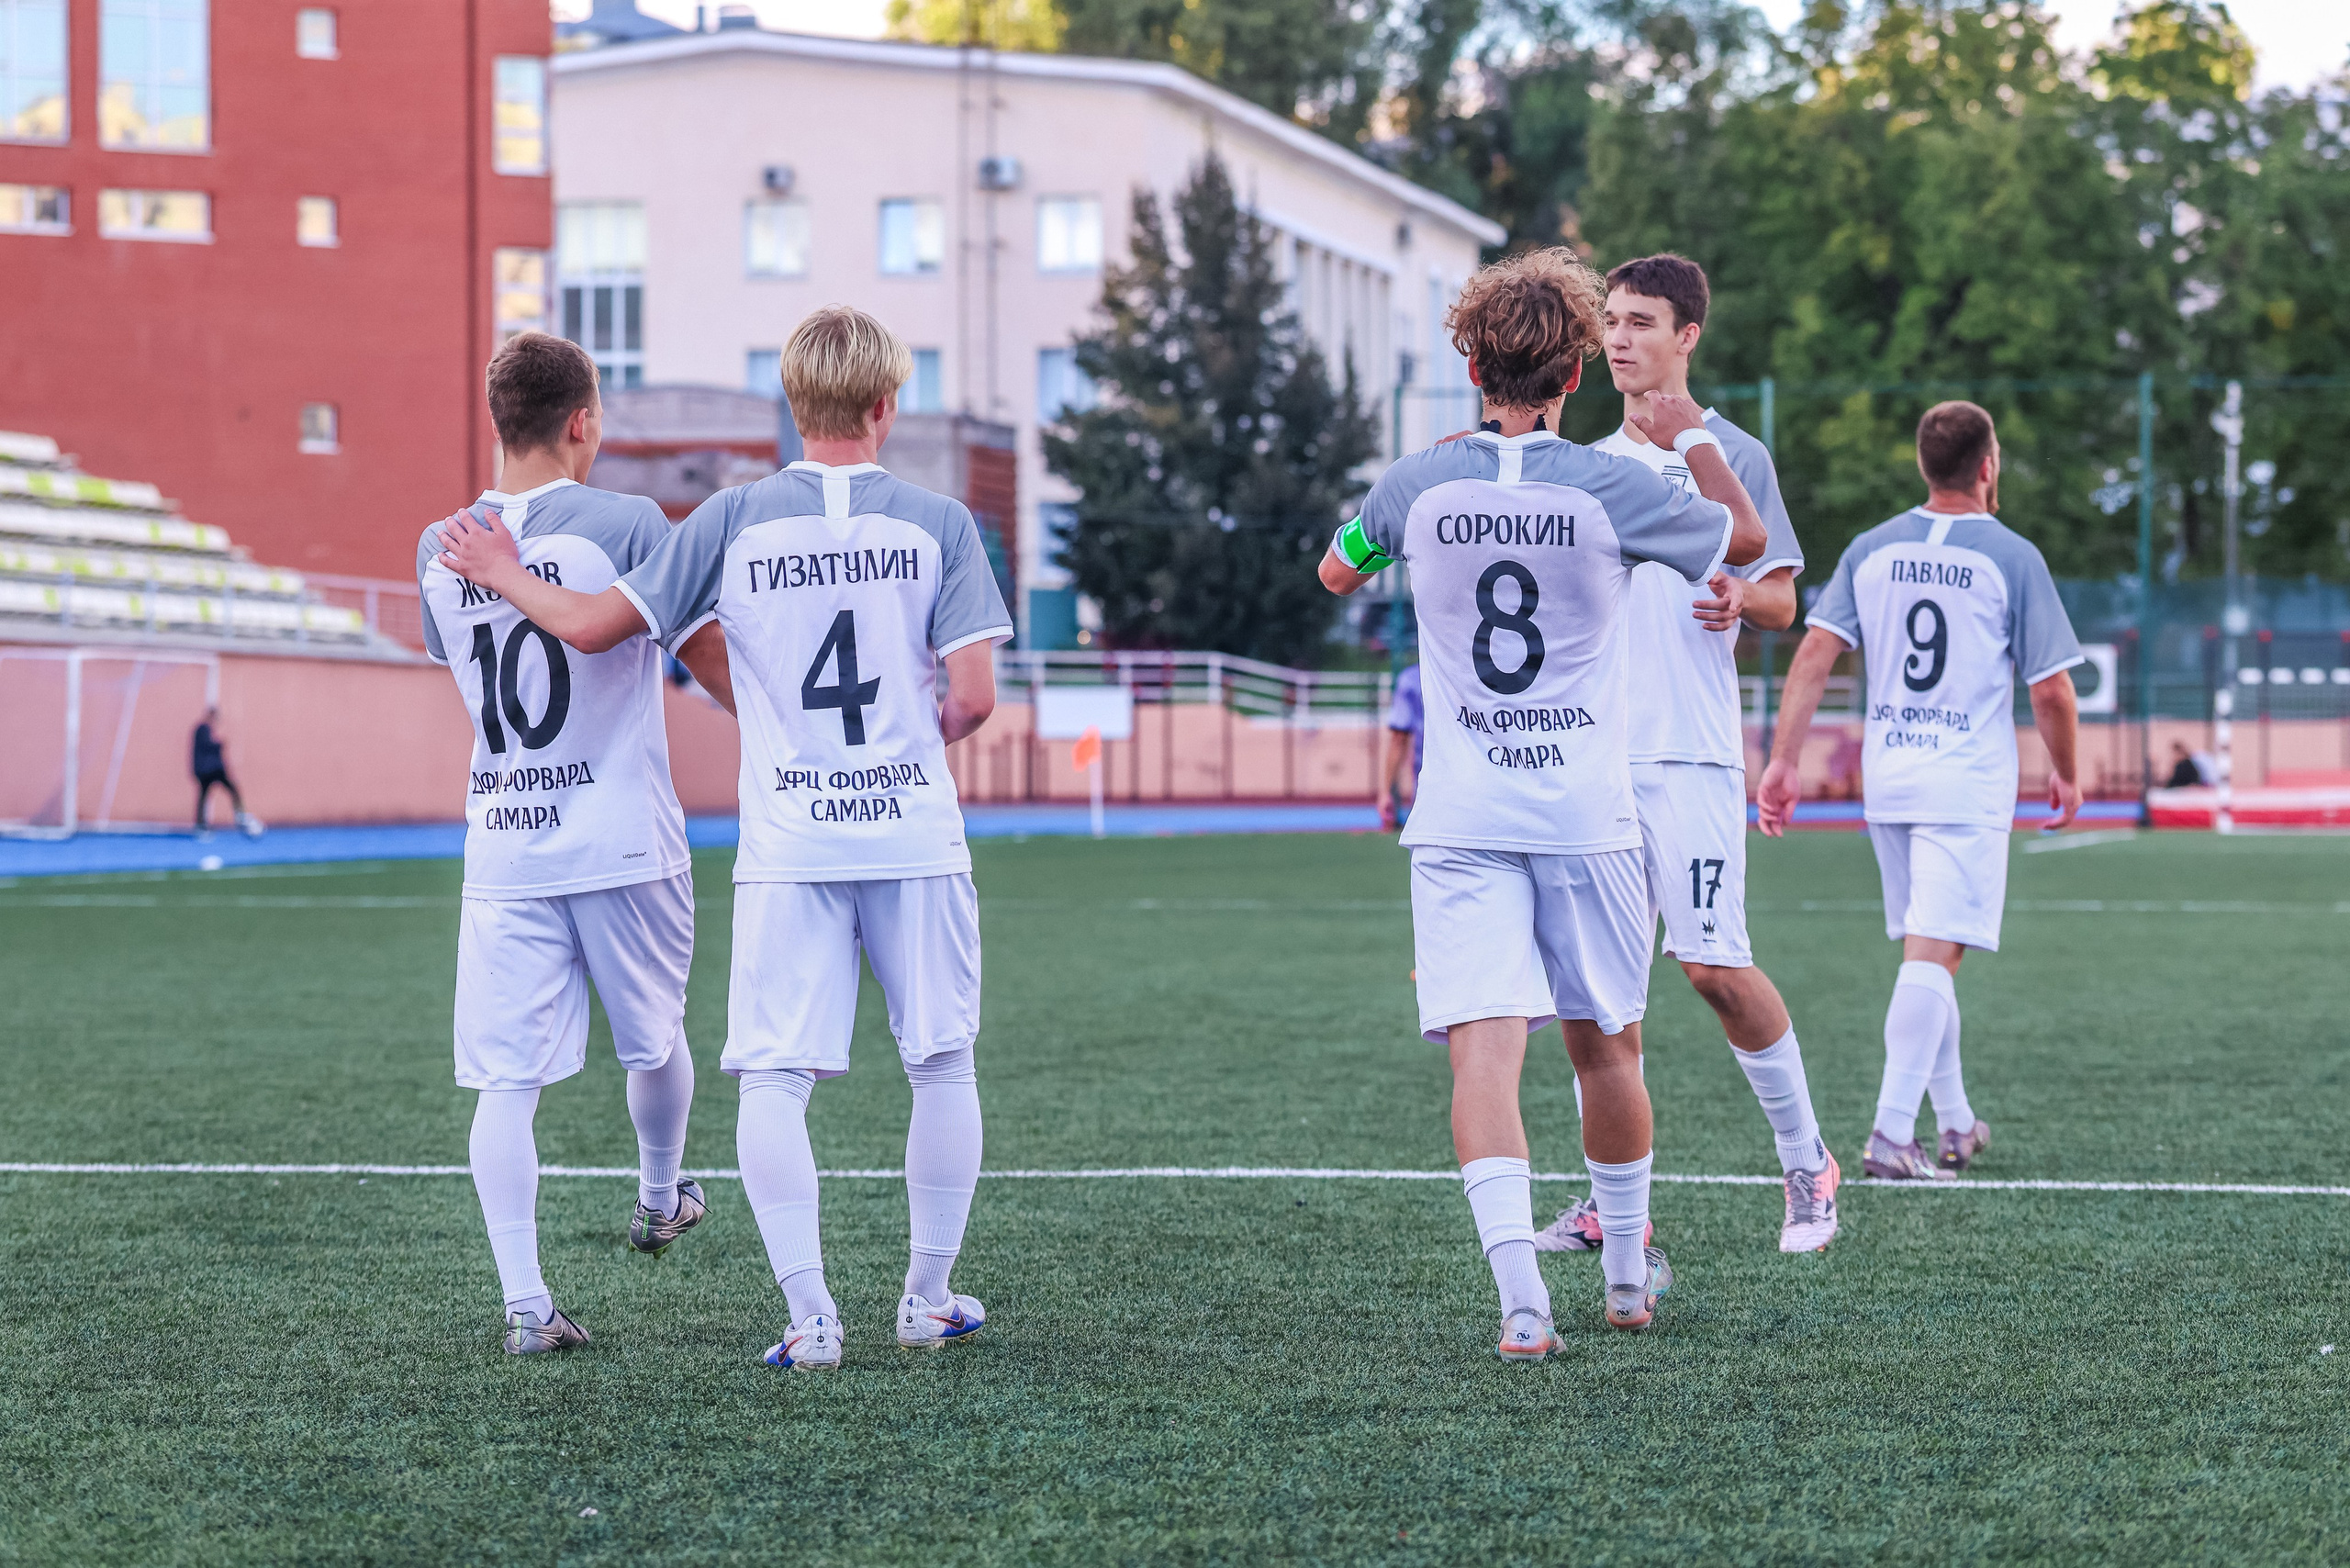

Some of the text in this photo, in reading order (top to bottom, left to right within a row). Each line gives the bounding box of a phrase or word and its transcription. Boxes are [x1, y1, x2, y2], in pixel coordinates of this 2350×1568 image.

[1436, 513, 1575, 547] СОРОКИН
[747, 547, 919, 593] ГИЗАТУЛИН
[1891, 560, 1973, 588] ПАВЛОВ
[1472, 559, 1546, 695] 8
[1903, 599, 1947, 692] 9
[469, 618, 571, 755] 10
[800, 610, 881, 745] 4
[1493, 707, 1595, 733] ФОРВАРД
[1901, 707, 1971, 732] ФОРВАРД
[1885, 732, 1940, 750] САМАРА
[1487, 744, 1565, 769] САМАРА
[775, 762, 930, 792] ДФЦ ФОРВАРД
[486, 805, 562, 830] САМАРА
[811, 797, 902, 822] САМАРА
[1688, 858, 1725, 909] 17
[816, 1316, 823, 1327] 4
